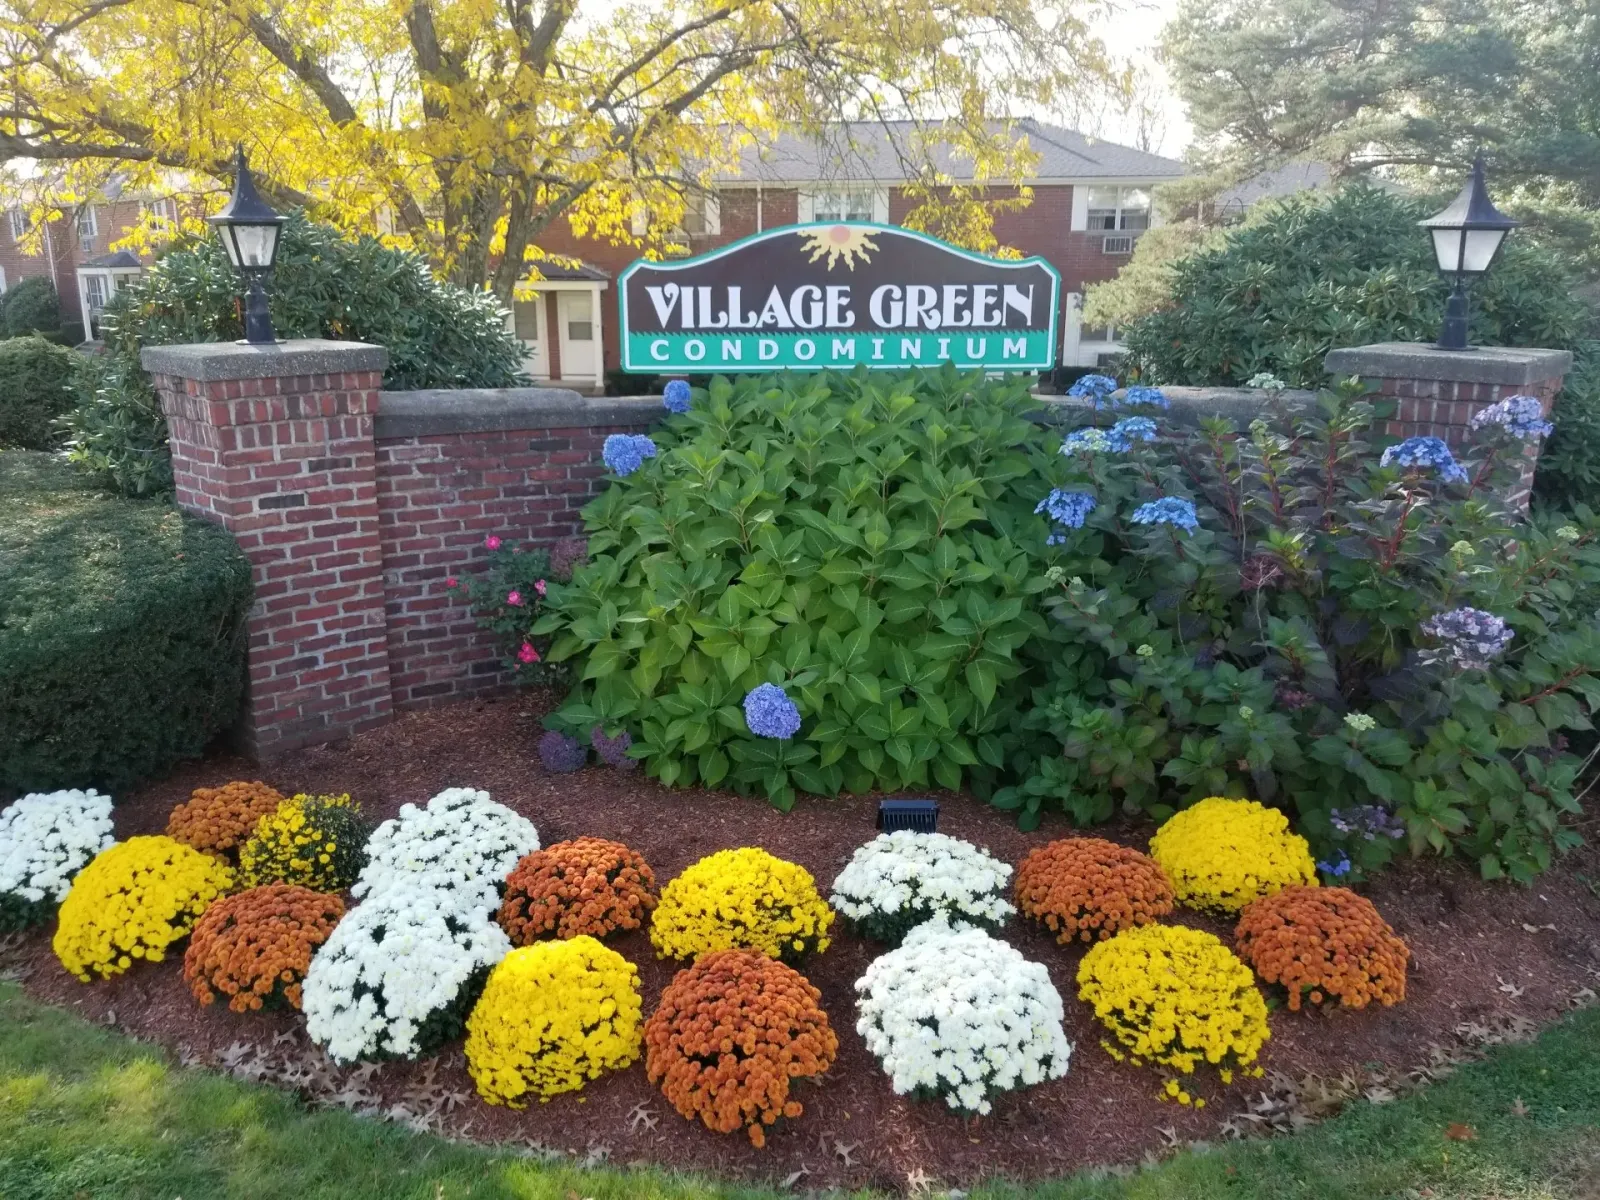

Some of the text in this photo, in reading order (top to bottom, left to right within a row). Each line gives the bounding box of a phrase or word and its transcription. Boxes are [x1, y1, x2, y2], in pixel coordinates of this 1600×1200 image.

[644, 282, 1035, 331] VILLAGE GREEN
[649, 337, 1028, 362] CONDOMINIUM
